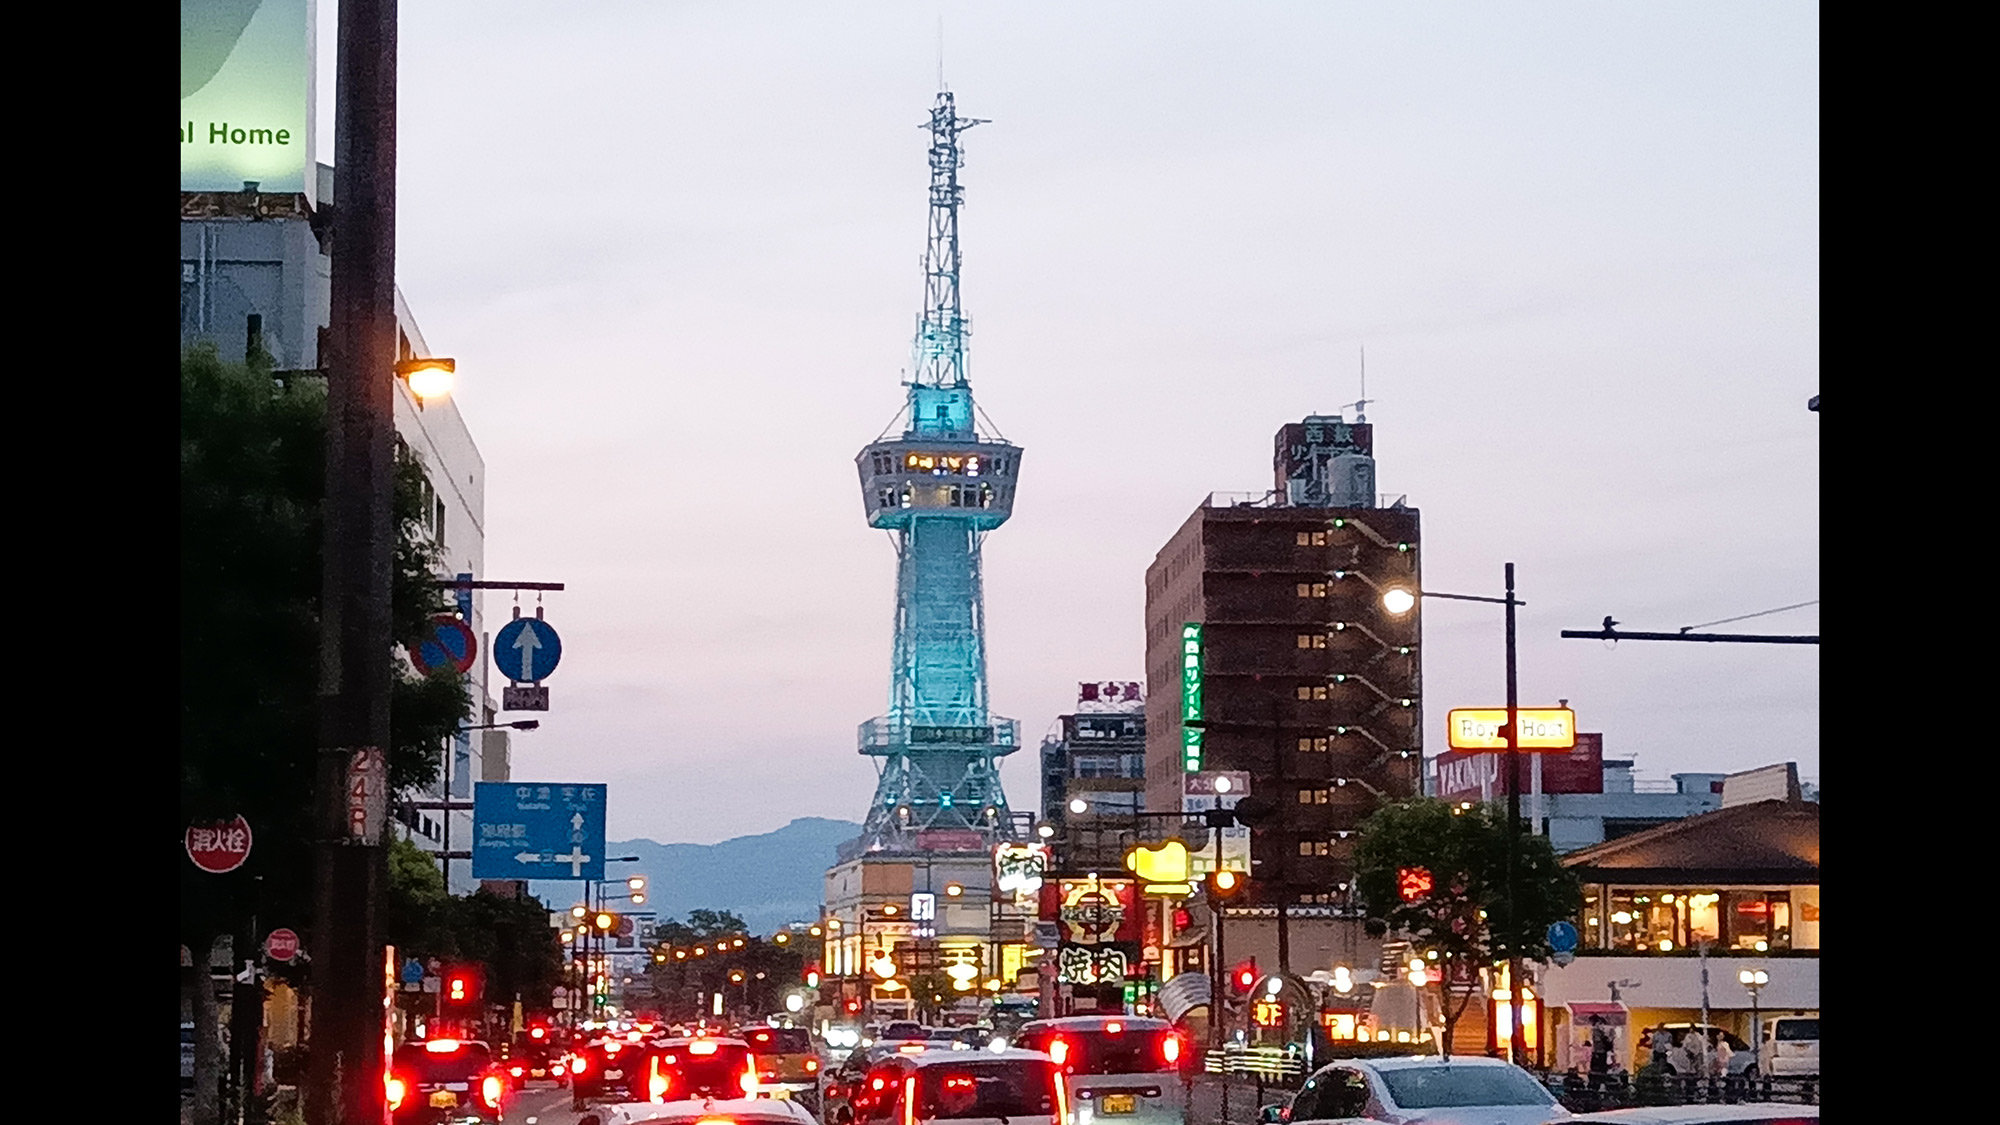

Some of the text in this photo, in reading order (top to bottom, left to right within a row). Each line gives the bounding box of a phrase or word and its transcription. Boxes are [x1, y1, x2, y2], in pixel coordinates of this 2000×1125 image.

[209, 122, 291, 145] Home
[1522, 720, 1565, 738] Host
[192, 827, 246, 853] 消火栓
[1060, 948, 1128, 985] 焼肉
